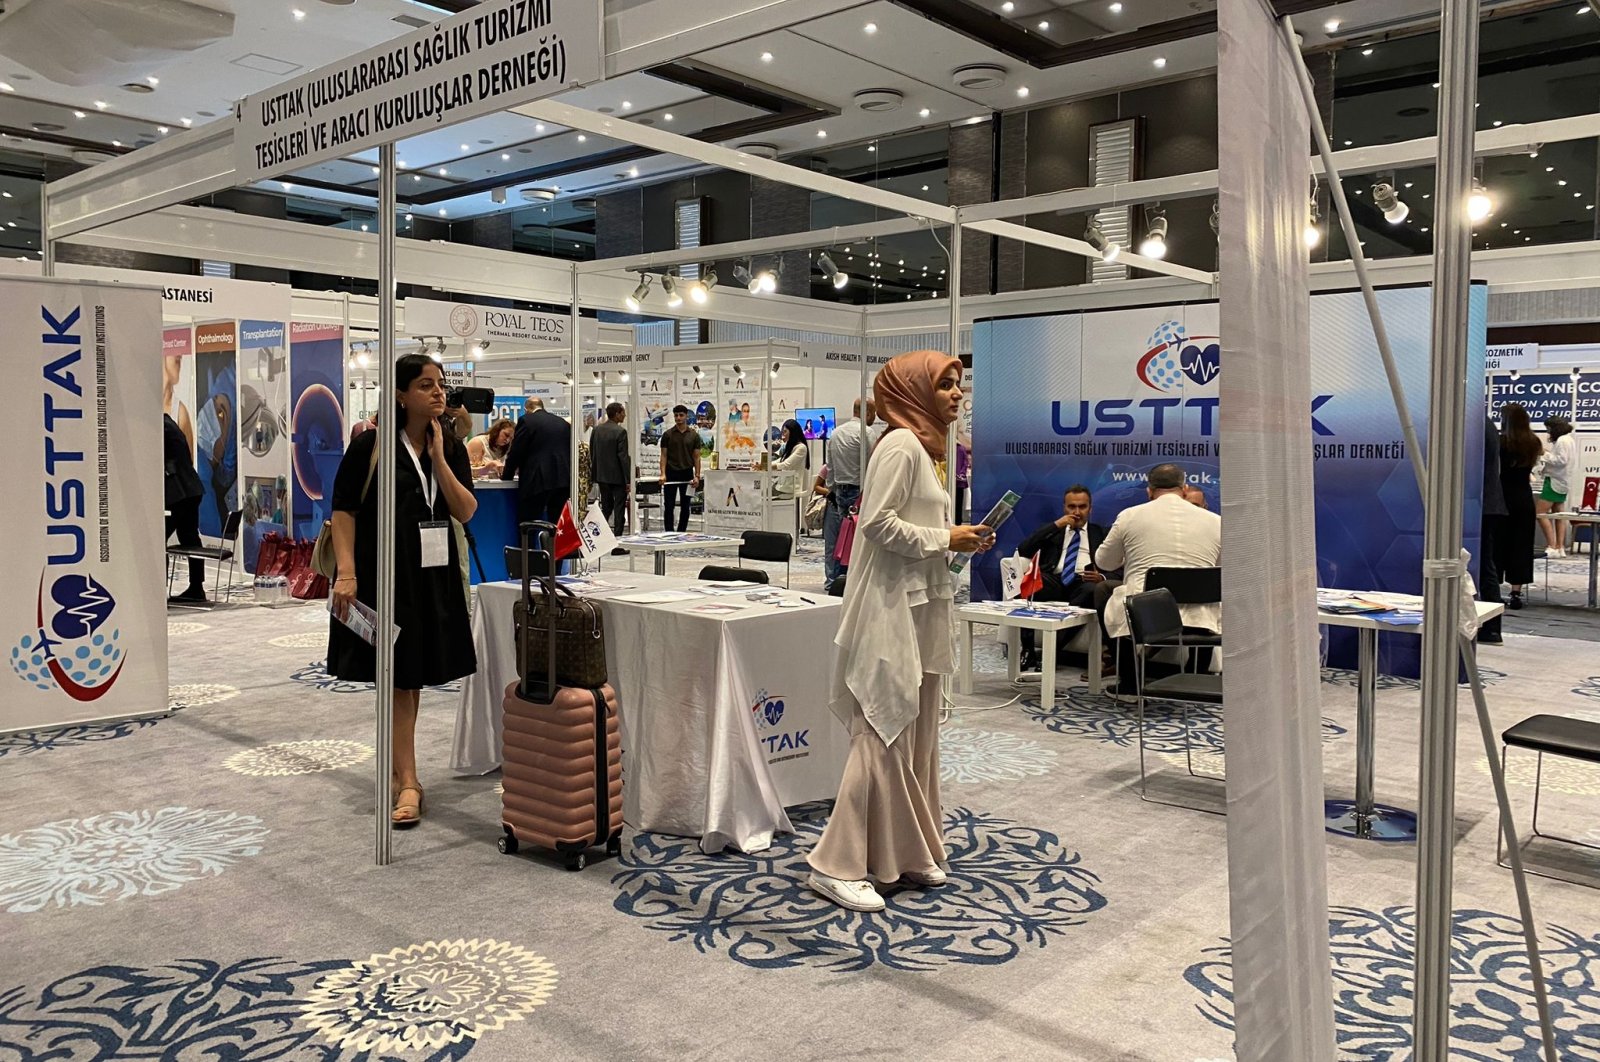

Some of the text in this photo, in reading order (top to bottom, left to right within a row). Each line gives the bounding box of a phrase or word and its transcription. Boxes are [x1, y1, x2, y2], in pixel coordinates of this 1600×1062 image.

[262, 86, 304, 128] USTTAK
[307, 47, 409, 119] (ULUSLARARASI
[414, 23, 471, 72] SAĞLIK
[255, 34, 567, 170] TESİSLERİ VE ARACI KURULUŞLAR DERNEĞİ)
[236, 103, 242, 122] 4
[485, 312, 564, 334] ROYAL TEOS
[198, 332, 234, 346] Ophthalmology
[243, 327, 282, 340] Transplantation
[597, 356, 612, 364] HEALTH
[636, 354, 650, 362] GENCY
[841, 353, 856, 362] HEALTH
[1486, 346, 1523, 358] OZMETİK
[1547, 410, 1600, 418] SURGER
[41, 305, 85, 565] USTTAK
[1006, 442, 1071, 456] ULUSLARARASI
[1074, 440, 1108, 456] SAĞLIK
[1112, 440, 1152, 456] TURİZMİ
[1157, 440, 1210, 457] TESİSLERİ
[1350, 440, 1404, 459] DERNEĞİ
